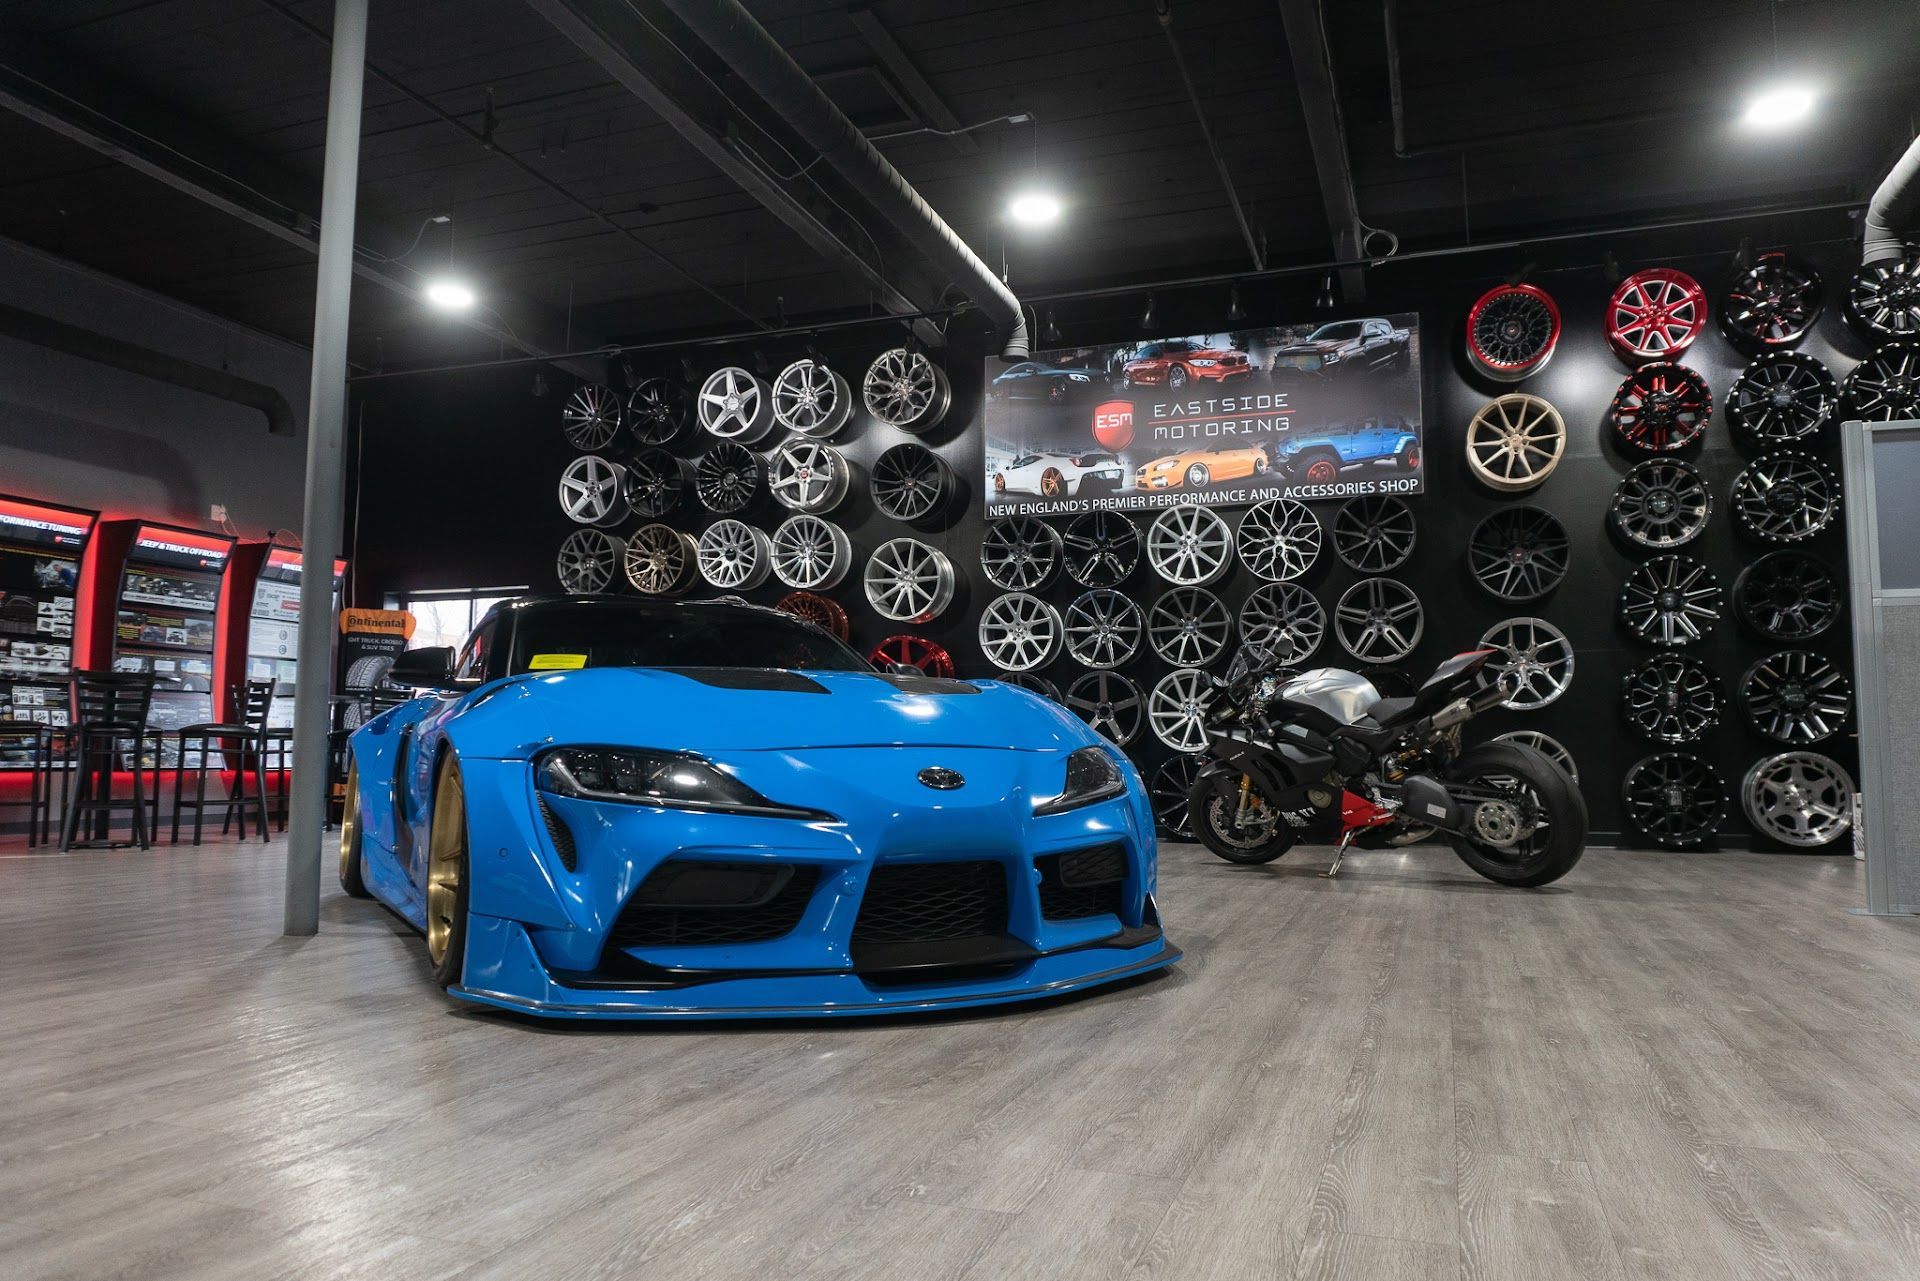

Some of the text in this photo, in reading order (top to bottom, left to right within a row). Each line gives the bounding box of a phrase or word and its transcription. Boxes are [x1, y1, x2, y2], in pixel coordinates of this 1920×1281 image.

[1154, 393, 1289, 418] EASTSIDE
[1096, 413, 1133, 428] ESM
[1154, 417, 1290, 440] MOTORING
[989, 478, 1419, 516] NEW ENGLAND'S PREMIER PERFORMANCE AND ACCESSORIES SHOP
[348, 615, 404, 628] Continental
